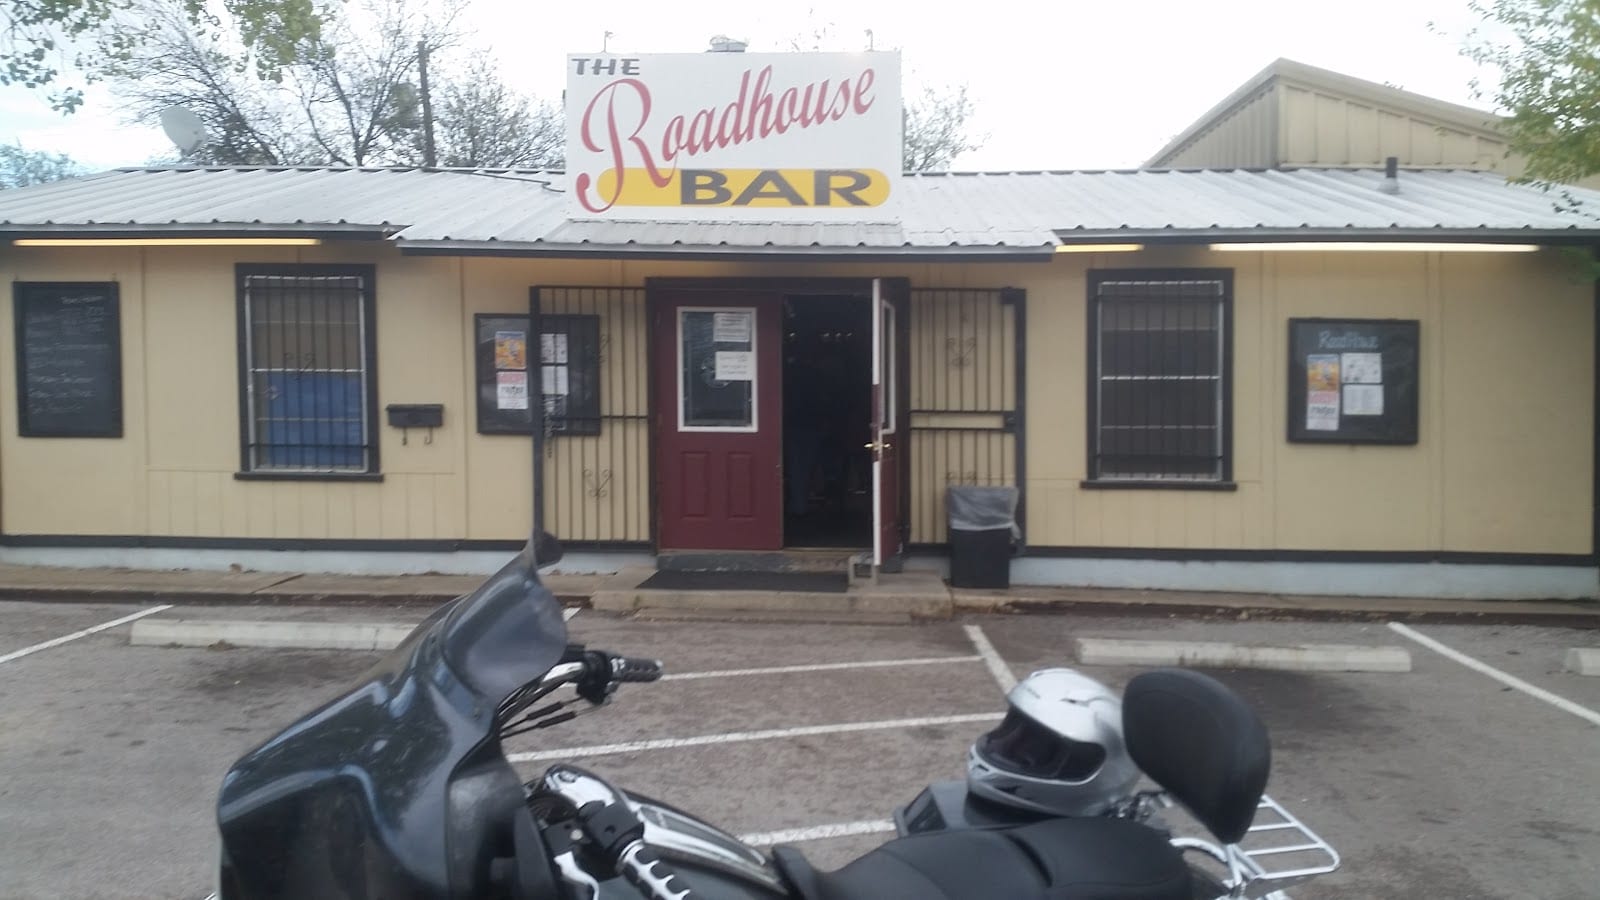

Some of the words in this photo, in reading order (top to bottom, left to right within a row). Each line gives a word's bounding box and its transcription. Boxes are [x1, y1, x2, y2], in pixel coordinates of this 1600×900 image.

[572, 58, 640, 76] THE
[576, 65, 875, 213] Roadhouse
[680, 169, 871, 206] BAR
